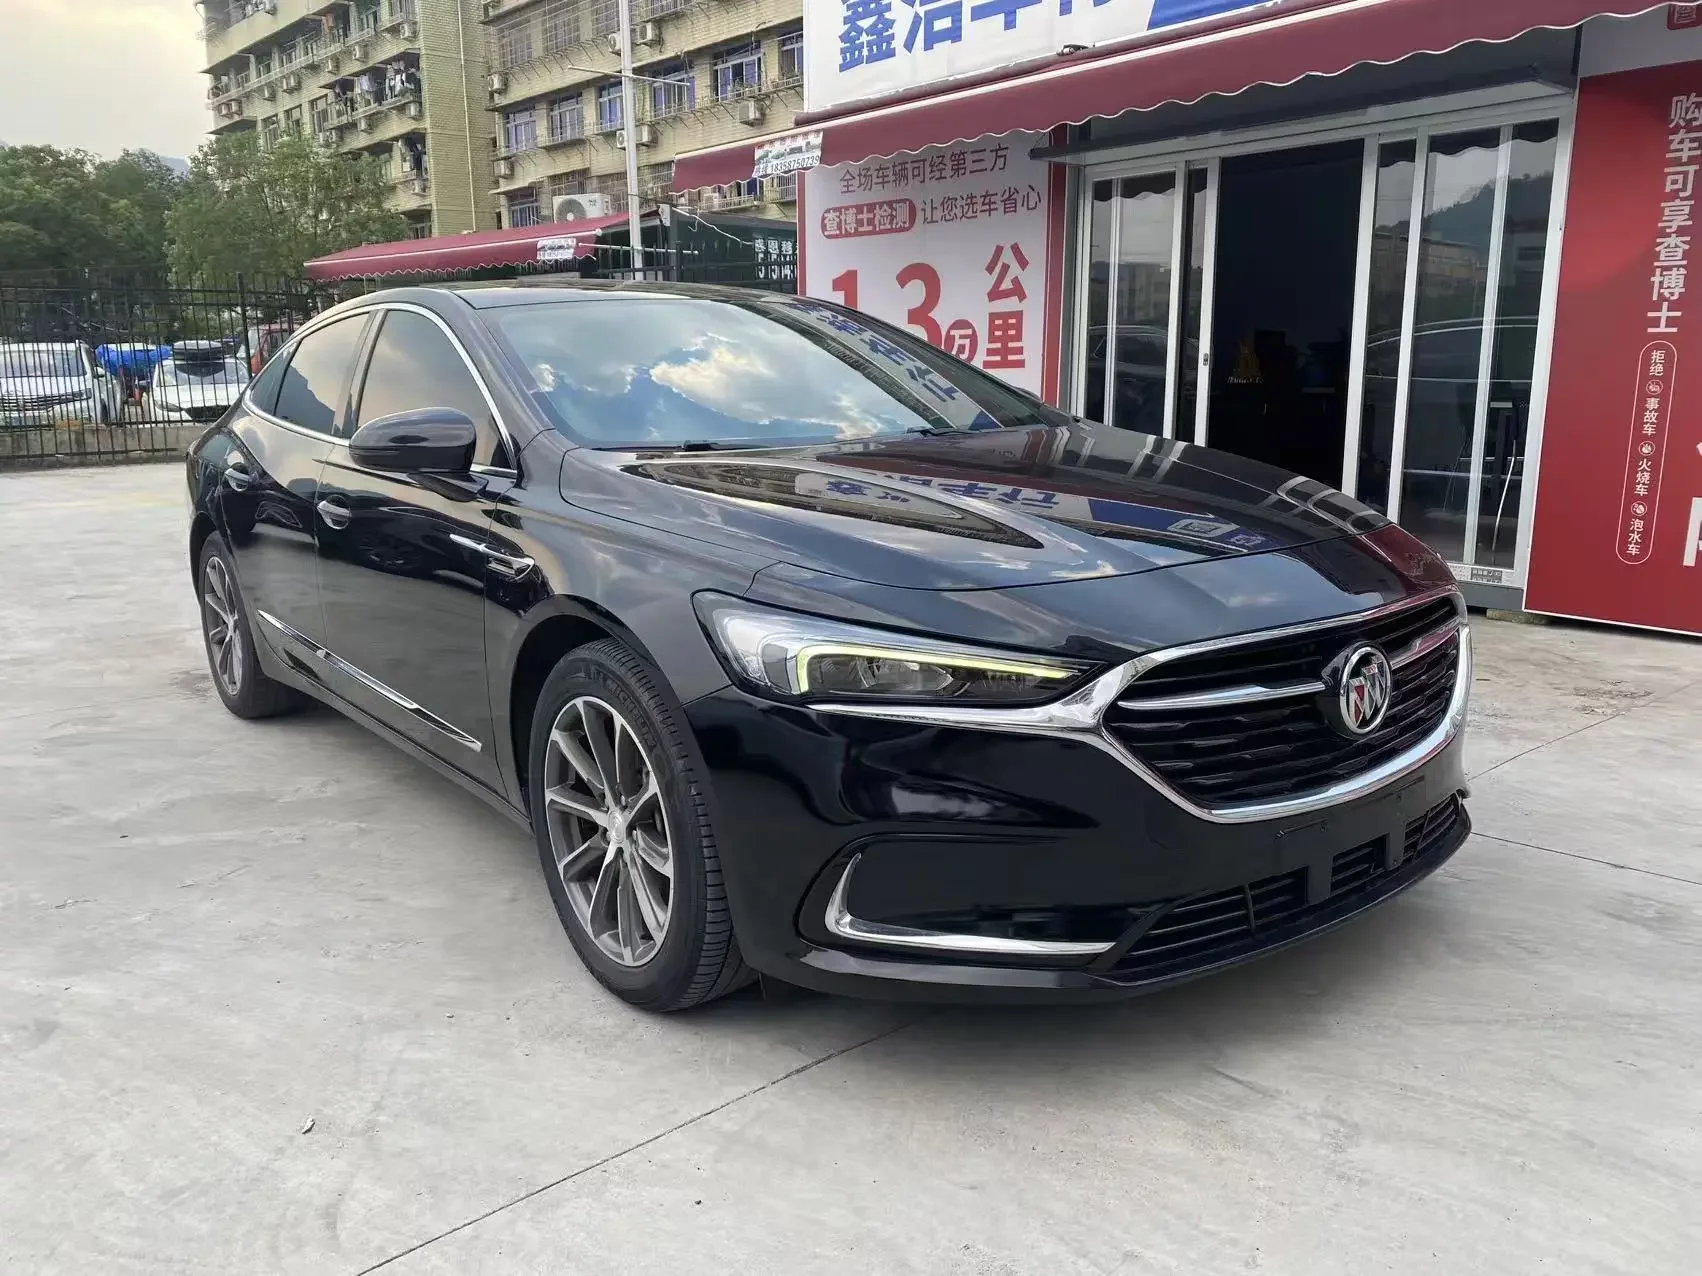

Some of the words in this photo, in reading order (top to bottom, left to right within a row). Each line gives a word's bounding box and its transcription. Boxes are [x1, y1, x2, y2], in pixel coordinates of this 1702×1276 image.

[839, 143, 1009, 195] 全场车辆可经第三方
[823, 201, 911, 235] 查博士检测
[921, 184, 1042, 225] 让您选车省心
[1647, 92, 1702, 333] 购车可享查博士
[1649, 349, 1666, 377] 拒绝
[1641, 396, 1661, 436] 事故车
[1634, 458, 1652, 496] 火烧车
[1626, 518, 1644, 556] 泡水车
